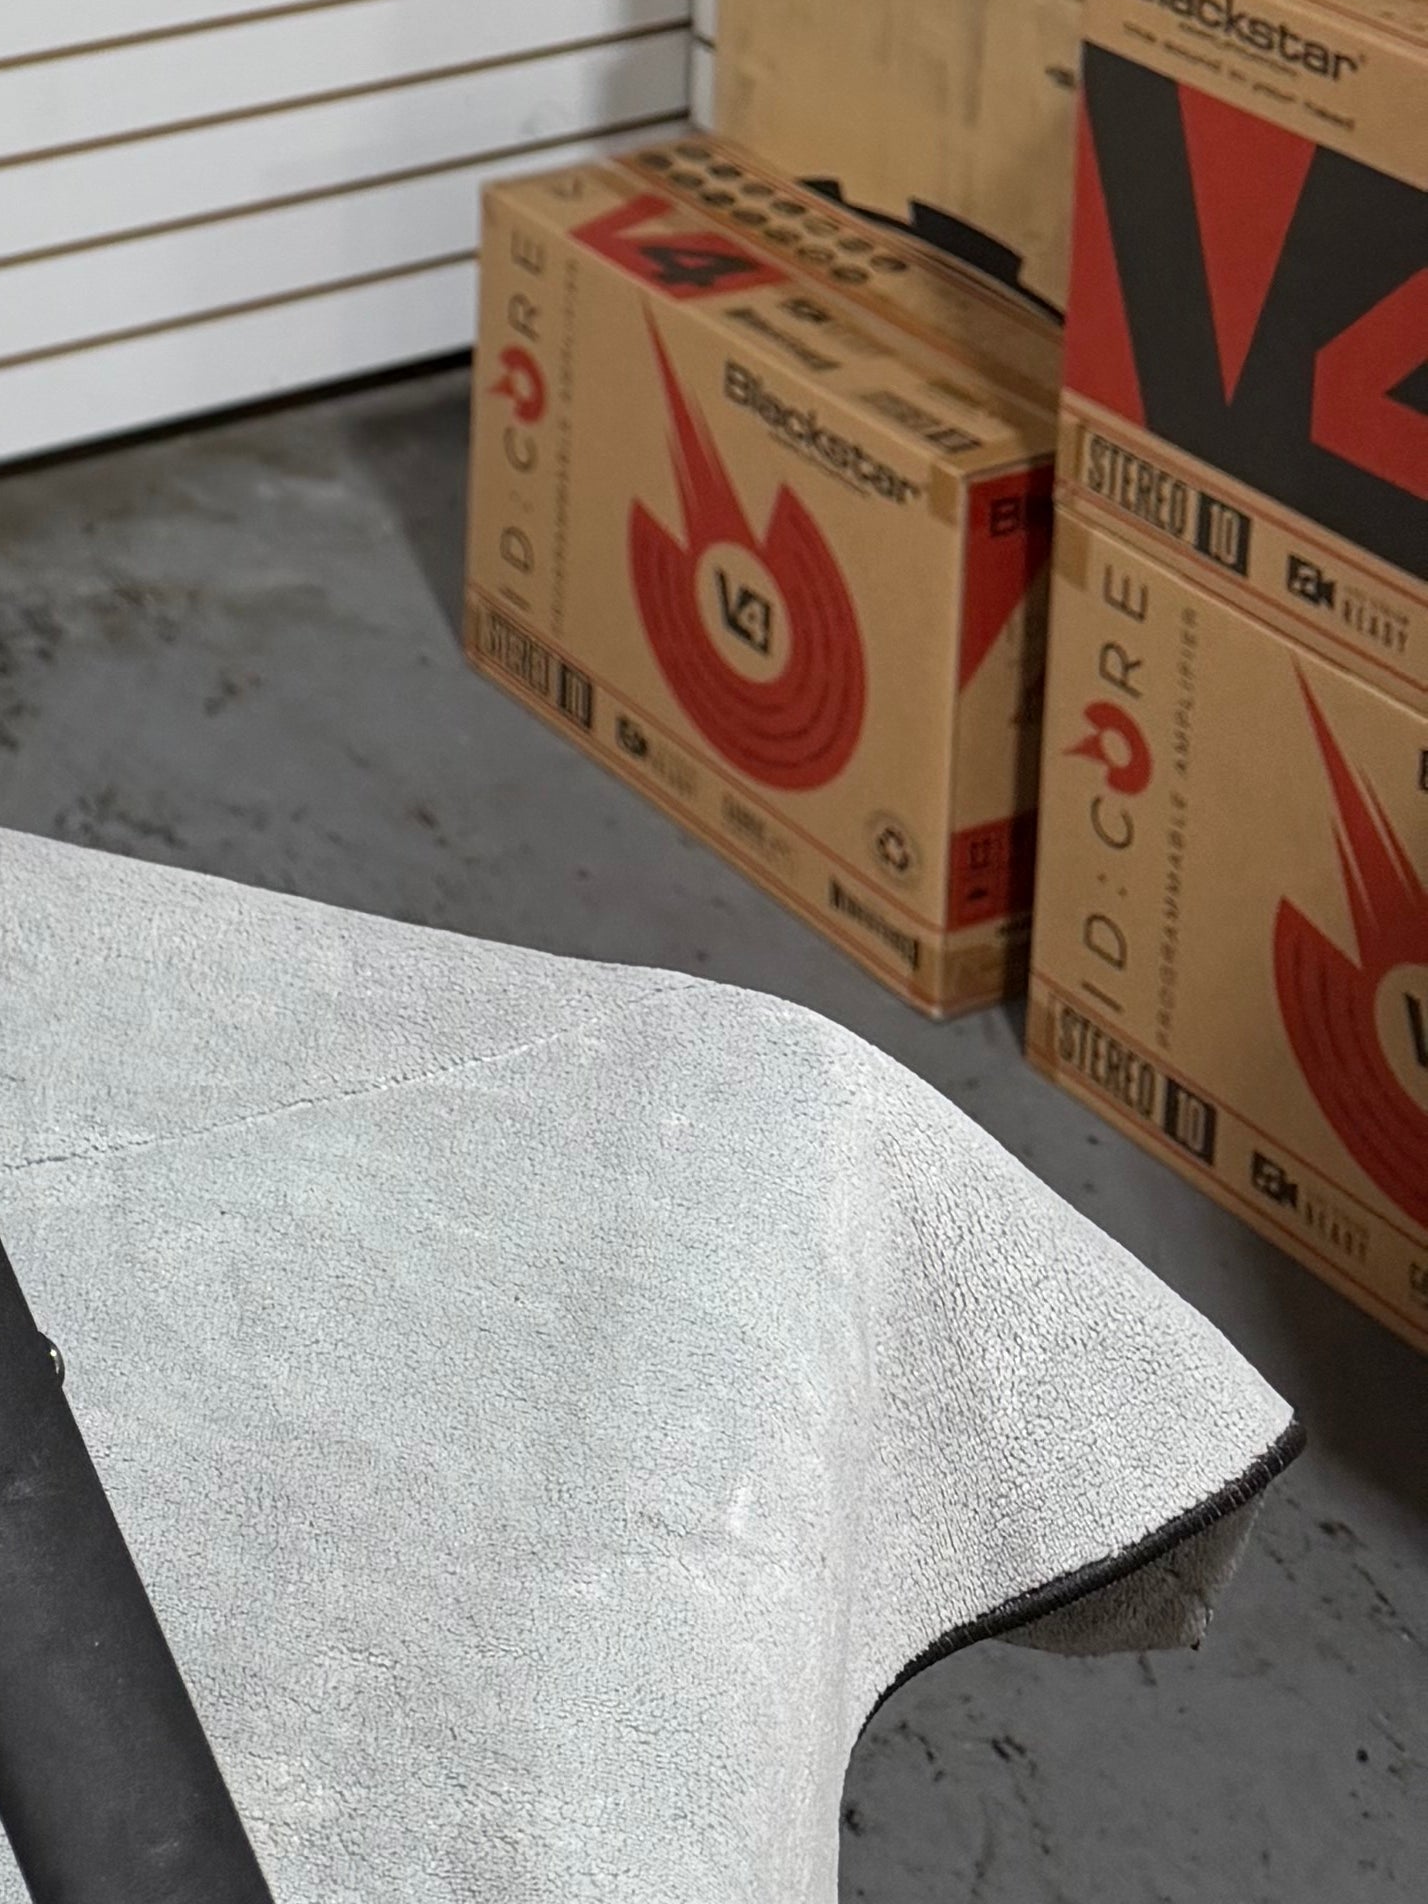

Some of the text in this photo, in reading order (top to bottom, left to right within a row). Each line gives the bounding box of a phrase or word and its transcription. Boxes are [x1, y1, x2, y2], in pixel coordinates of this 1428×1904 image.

[724, 359, 922, 504] Blackstar
[1086, 434, 1192, 540] STEREO
[1155, 607, 1200, 1054] PROGRAMMABLE AMPLIFIER
[1058, 1006, 1156, 1120] STEREO
